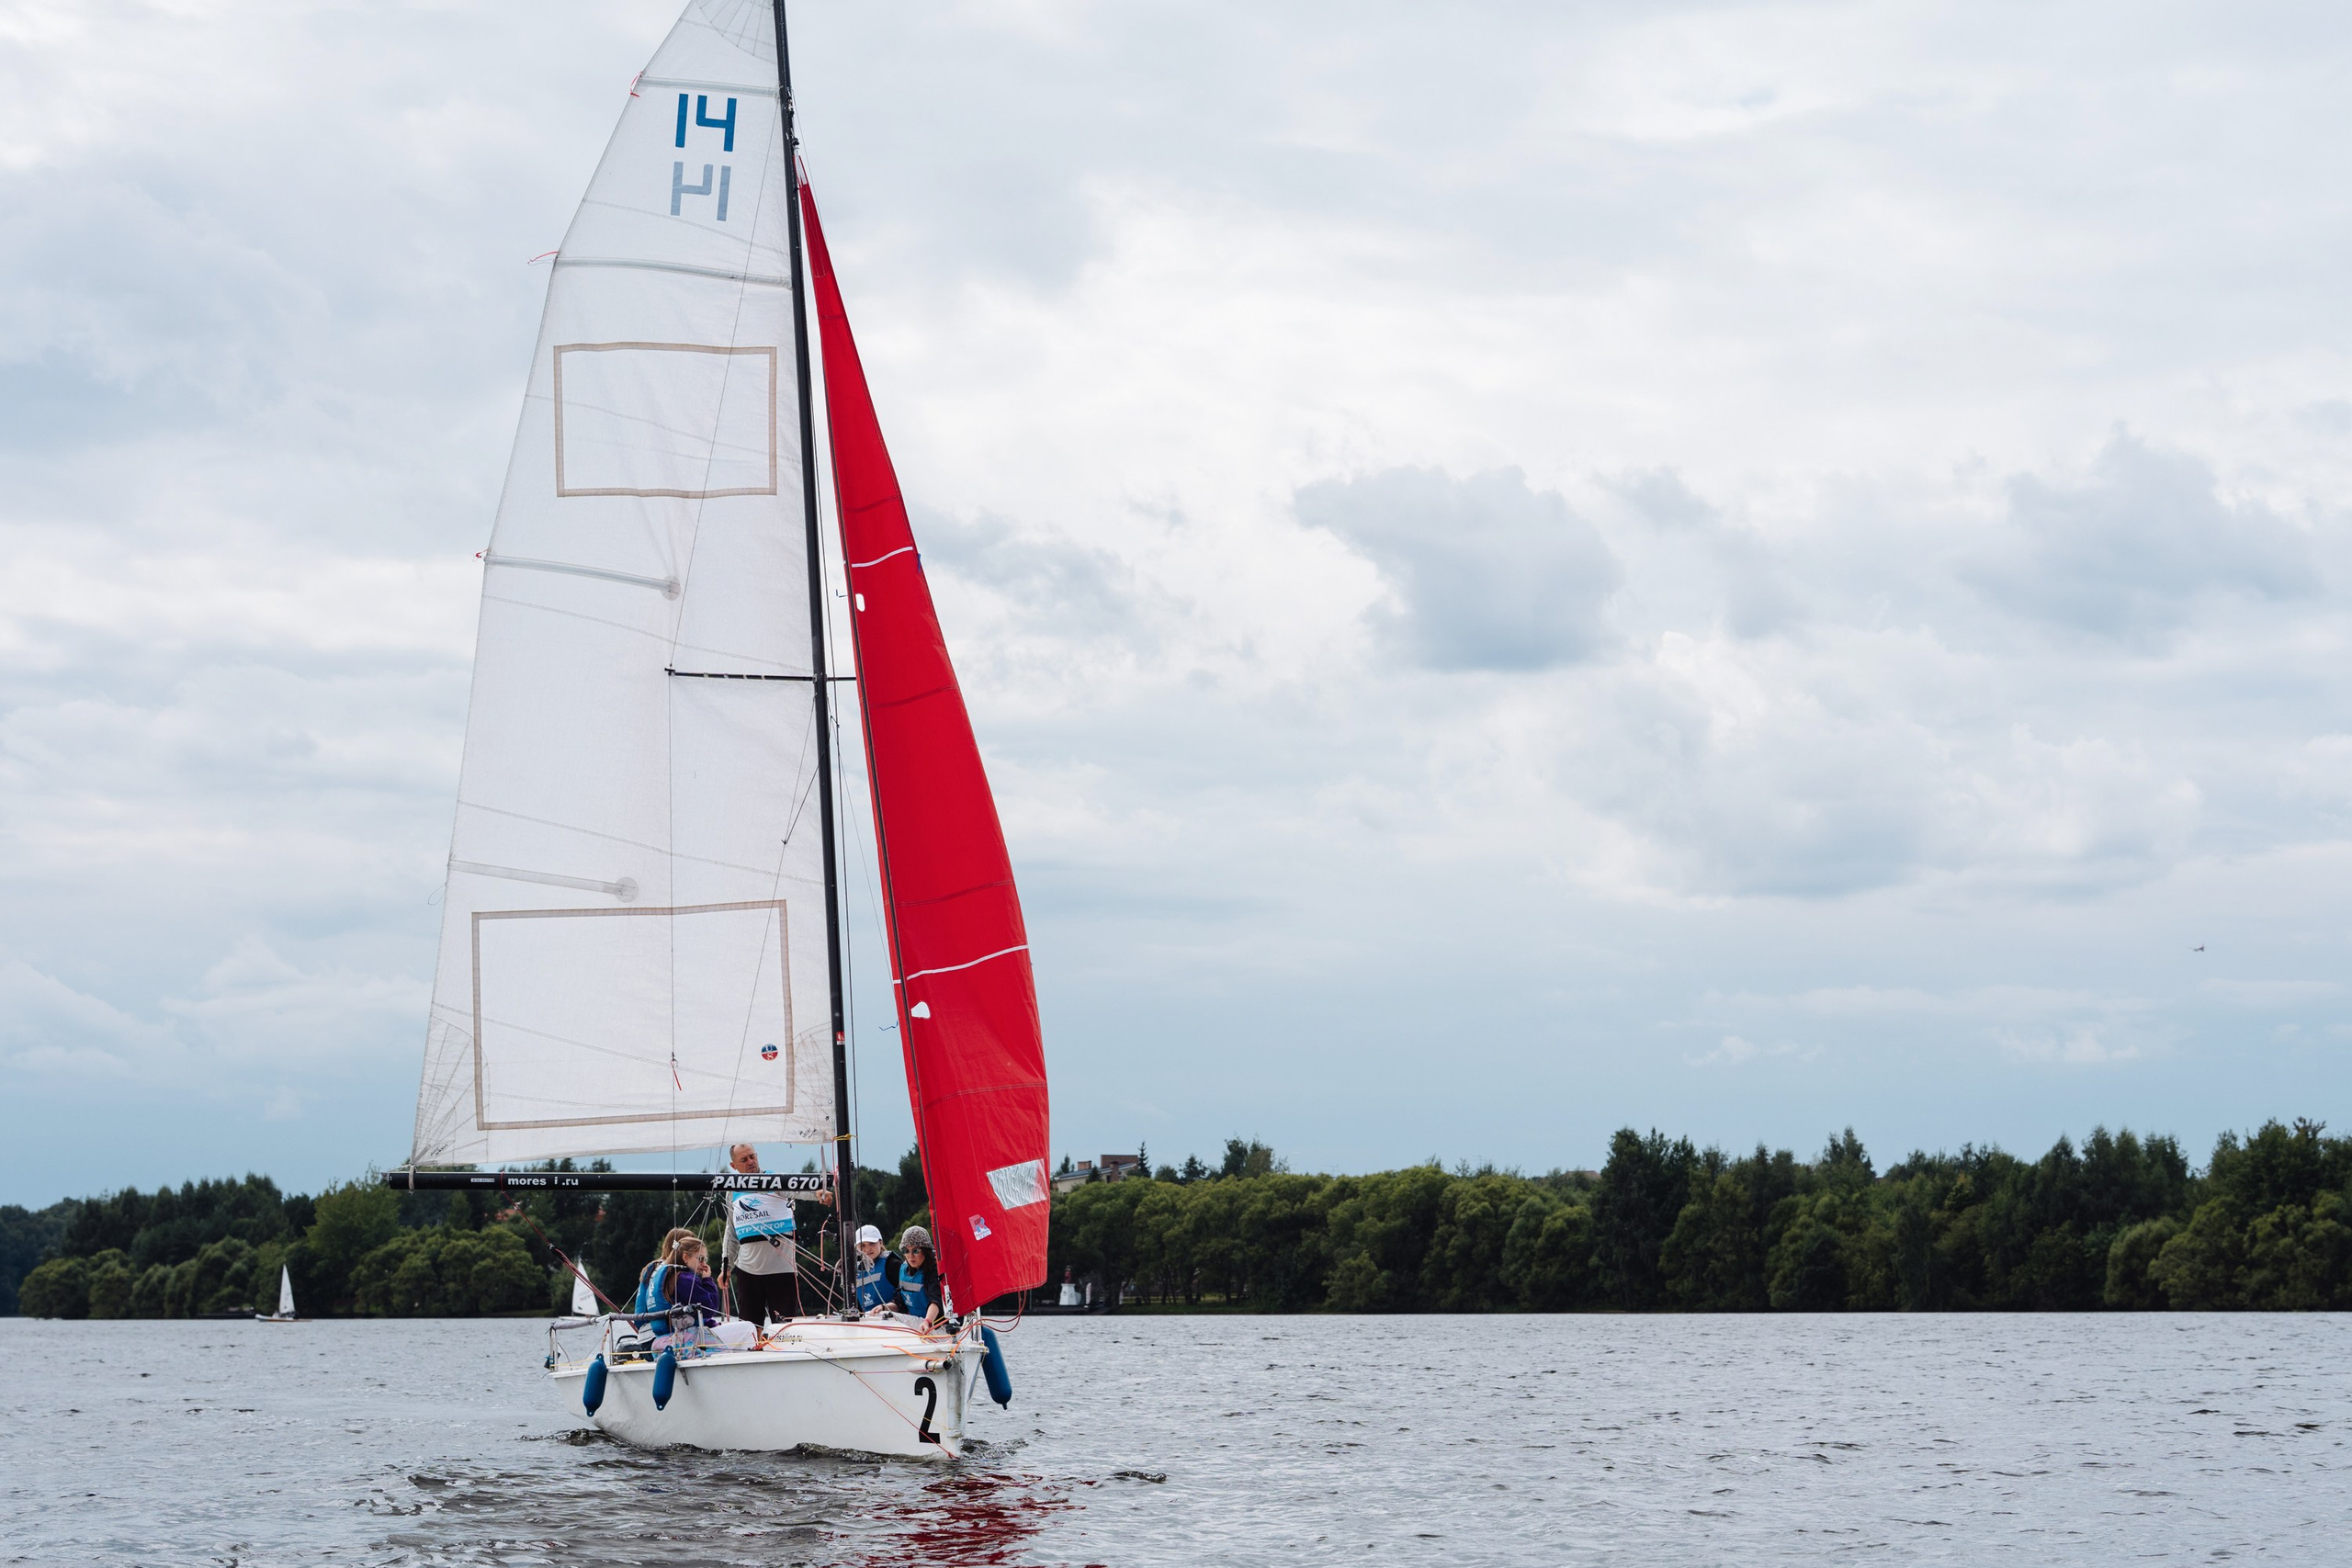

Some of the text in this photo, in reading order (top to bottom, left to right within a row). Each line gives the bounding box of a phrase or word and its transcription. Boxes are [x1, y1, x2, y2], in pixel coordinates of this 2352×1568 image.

[675, 93, 737, 152] 14
[787, 1177, 820, 1190] 670
[735, 1210, 771, 1223] MORESAIL
[735, 1221, 786, 1235] СТРУКТОР
[914, 1376, 941, 1445] 2
